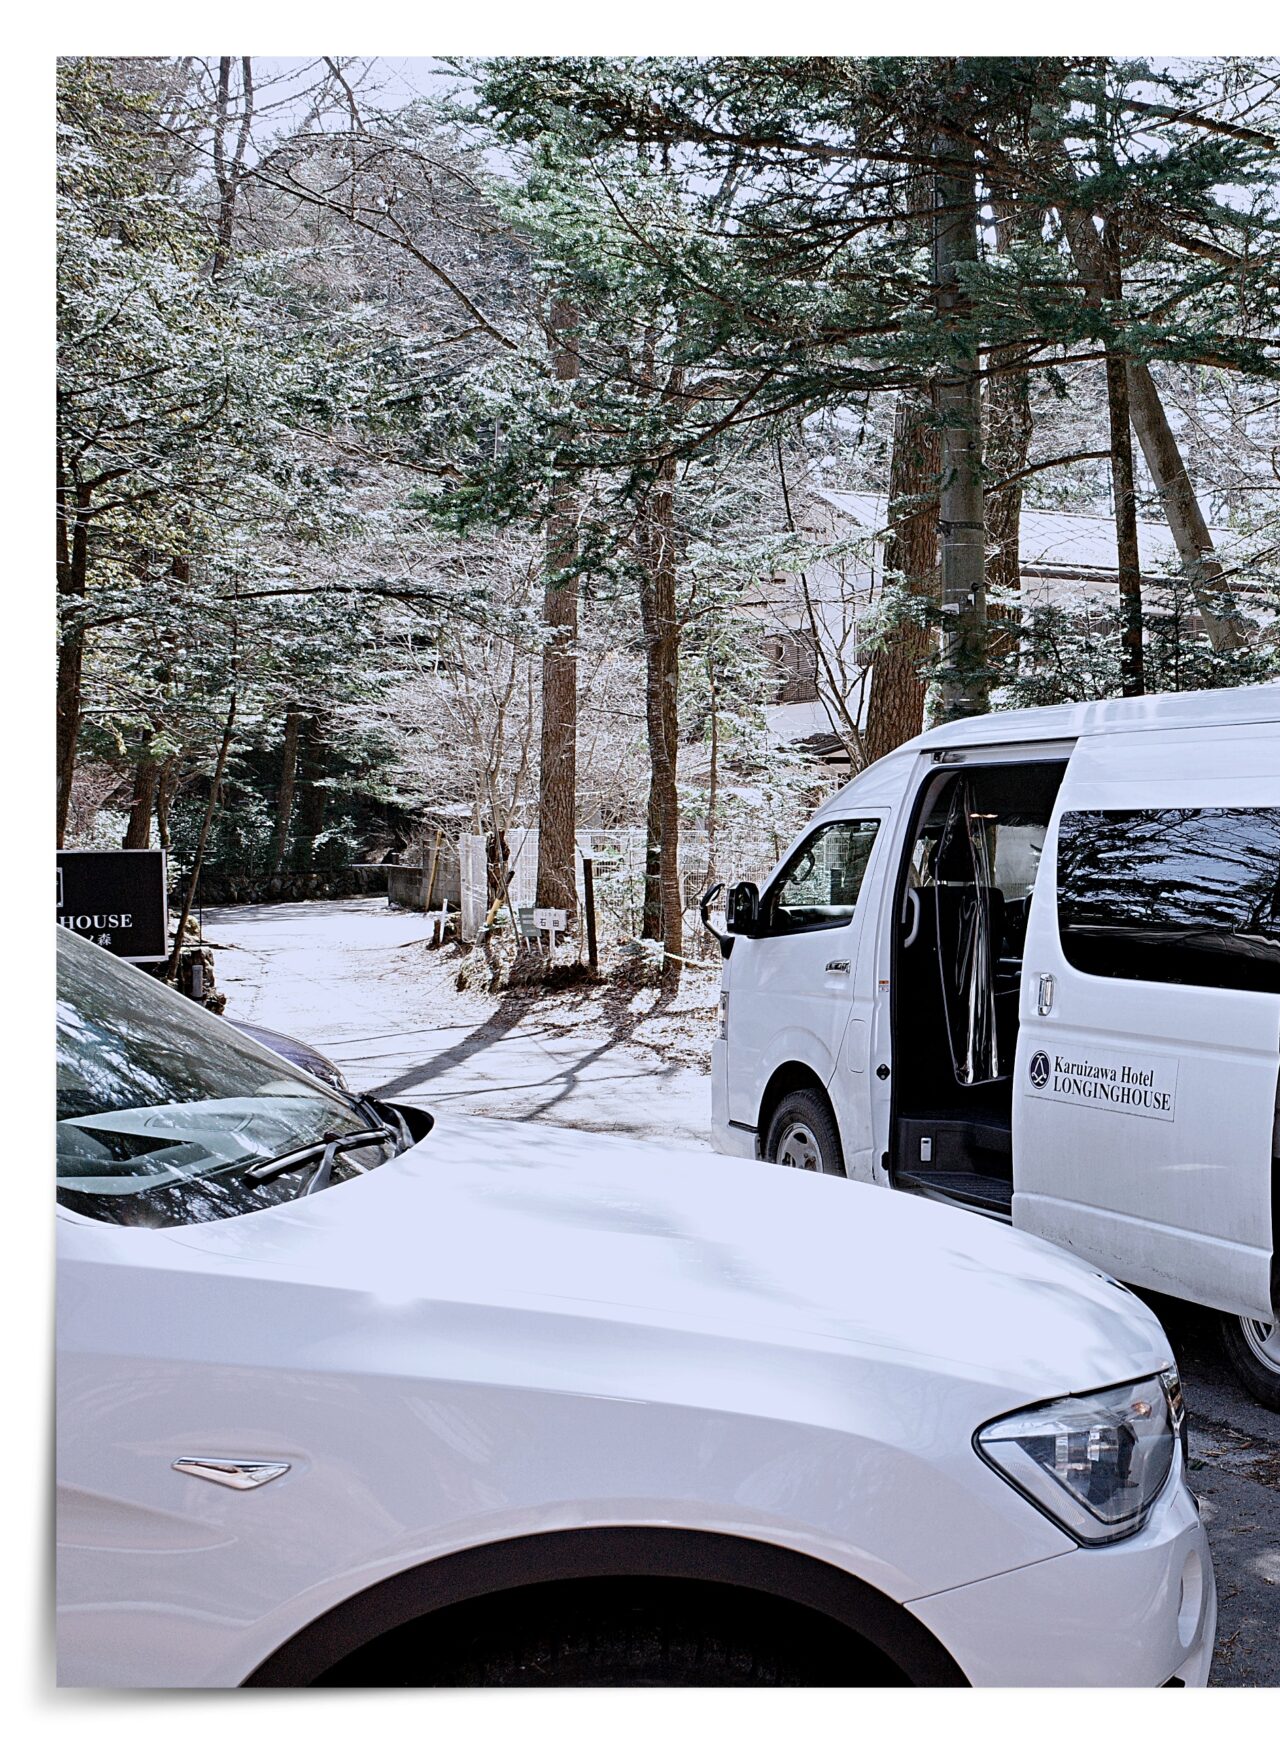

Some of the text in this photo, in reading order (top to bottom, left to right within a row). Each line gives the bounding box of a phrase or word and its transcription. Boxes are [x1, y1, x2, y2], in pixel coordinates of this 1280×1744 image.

[1054, 1056, 1155, 1088] Karuizawa Hotel
[1053, 1076, 1172, 1111] LONGINGHOUSE
